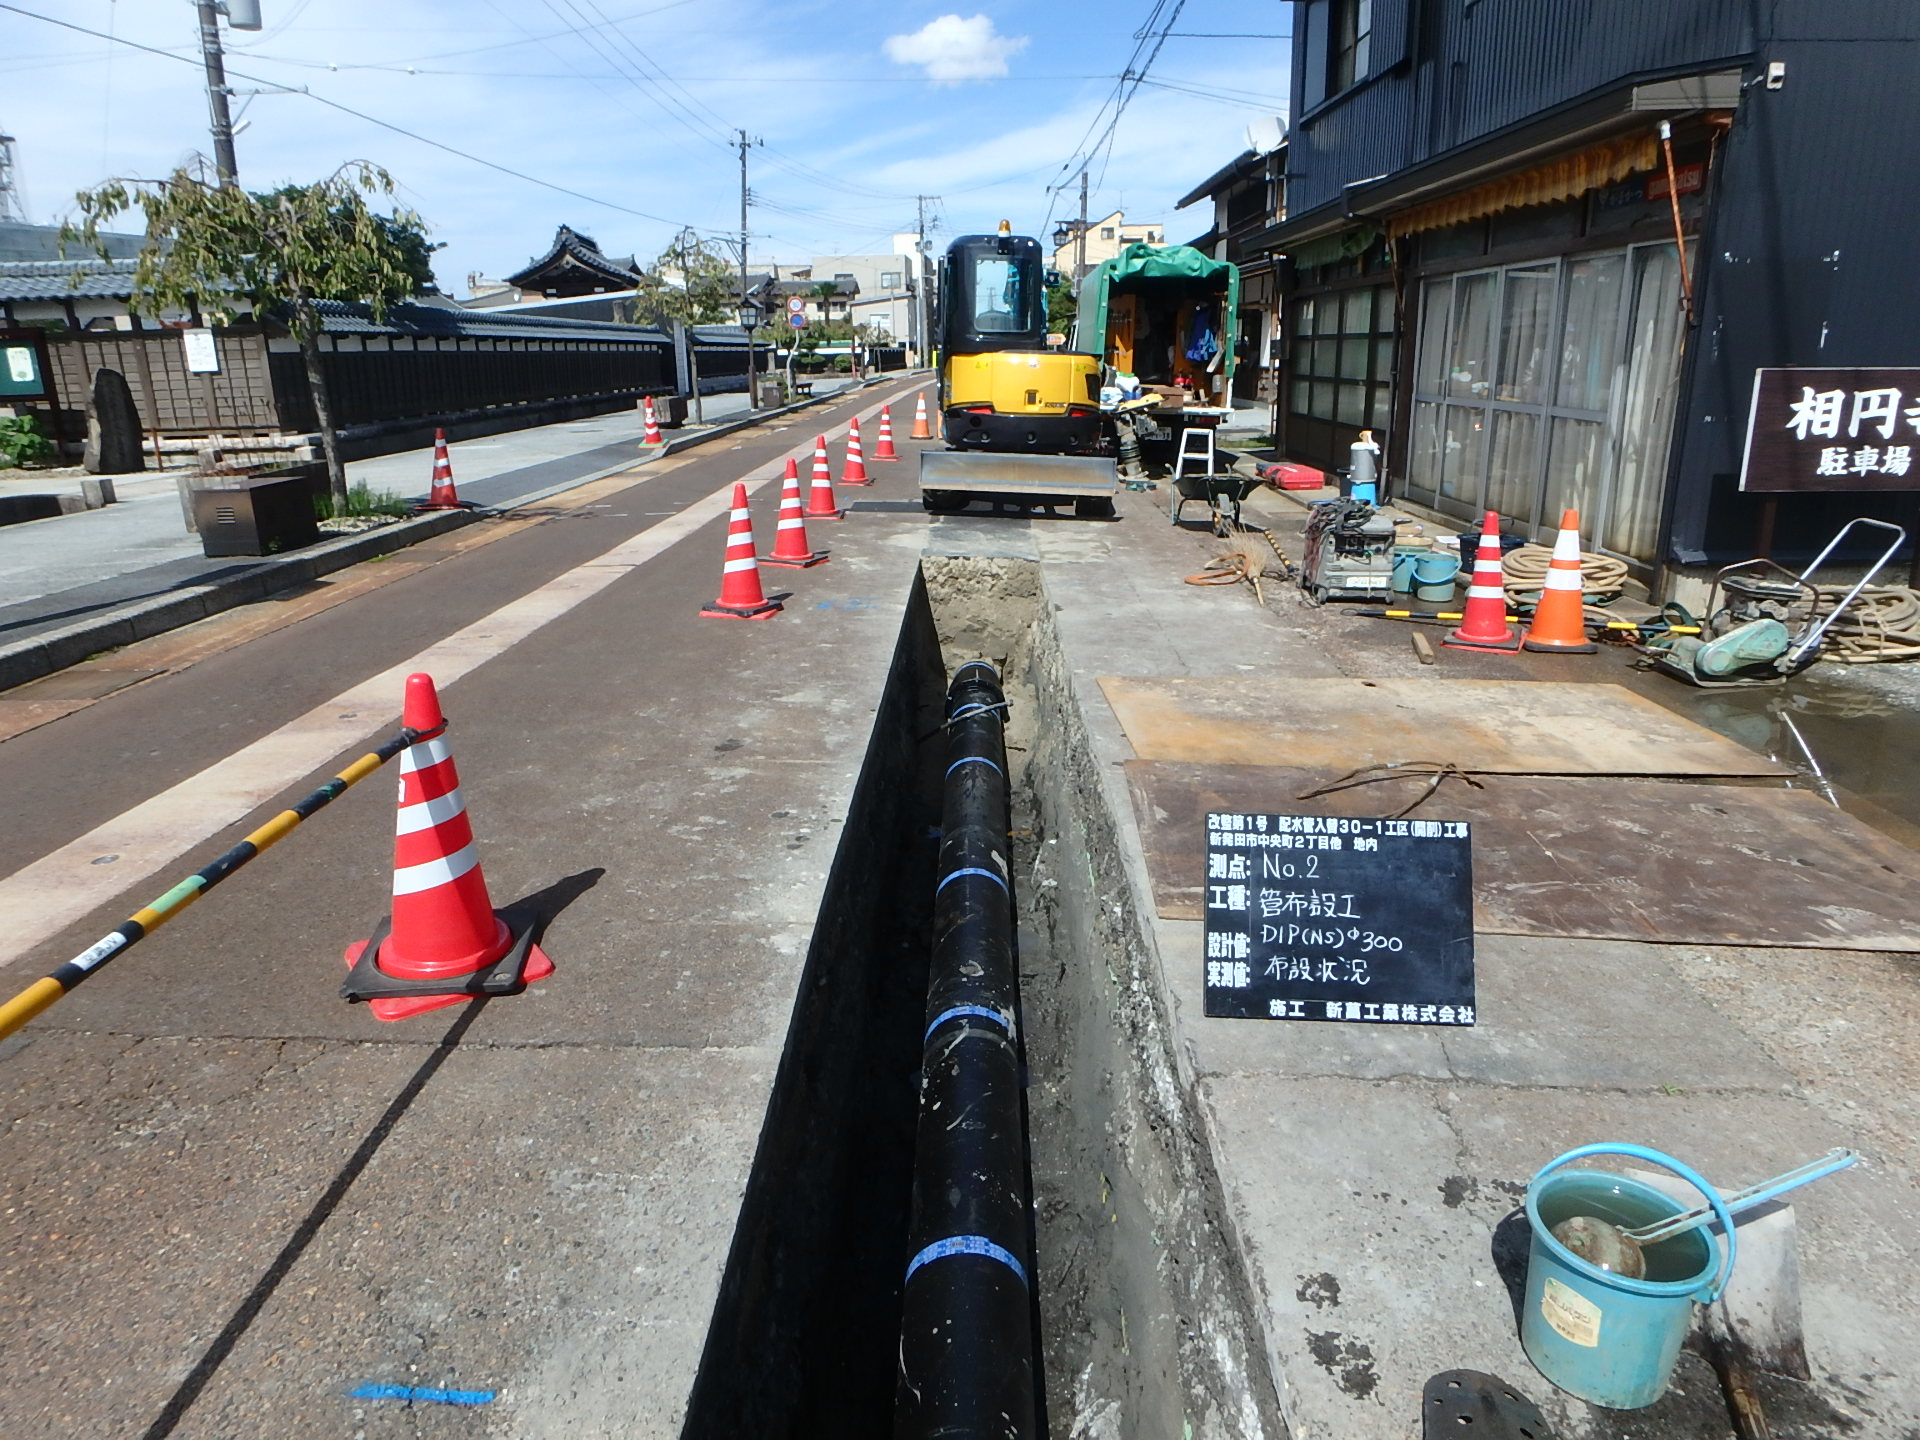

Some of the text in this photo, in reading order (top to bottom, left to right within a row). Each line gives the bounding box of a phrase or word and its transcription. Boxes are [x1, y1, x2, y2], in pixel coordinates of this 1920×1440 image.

[1784, 386, 1920, 440] 相円
[1816, 445, 1912, 477] 駐車場
[1209, 832, 1378, 852] 新発田市中央町2丁目他 地内
[1262, 852, 1320, 879] No.2
[1260, 888, 1361, 918] 管布設工
[1264, 955, 1371, 986] 布設状況
[1269, 999, 1305, 1017] 施工
